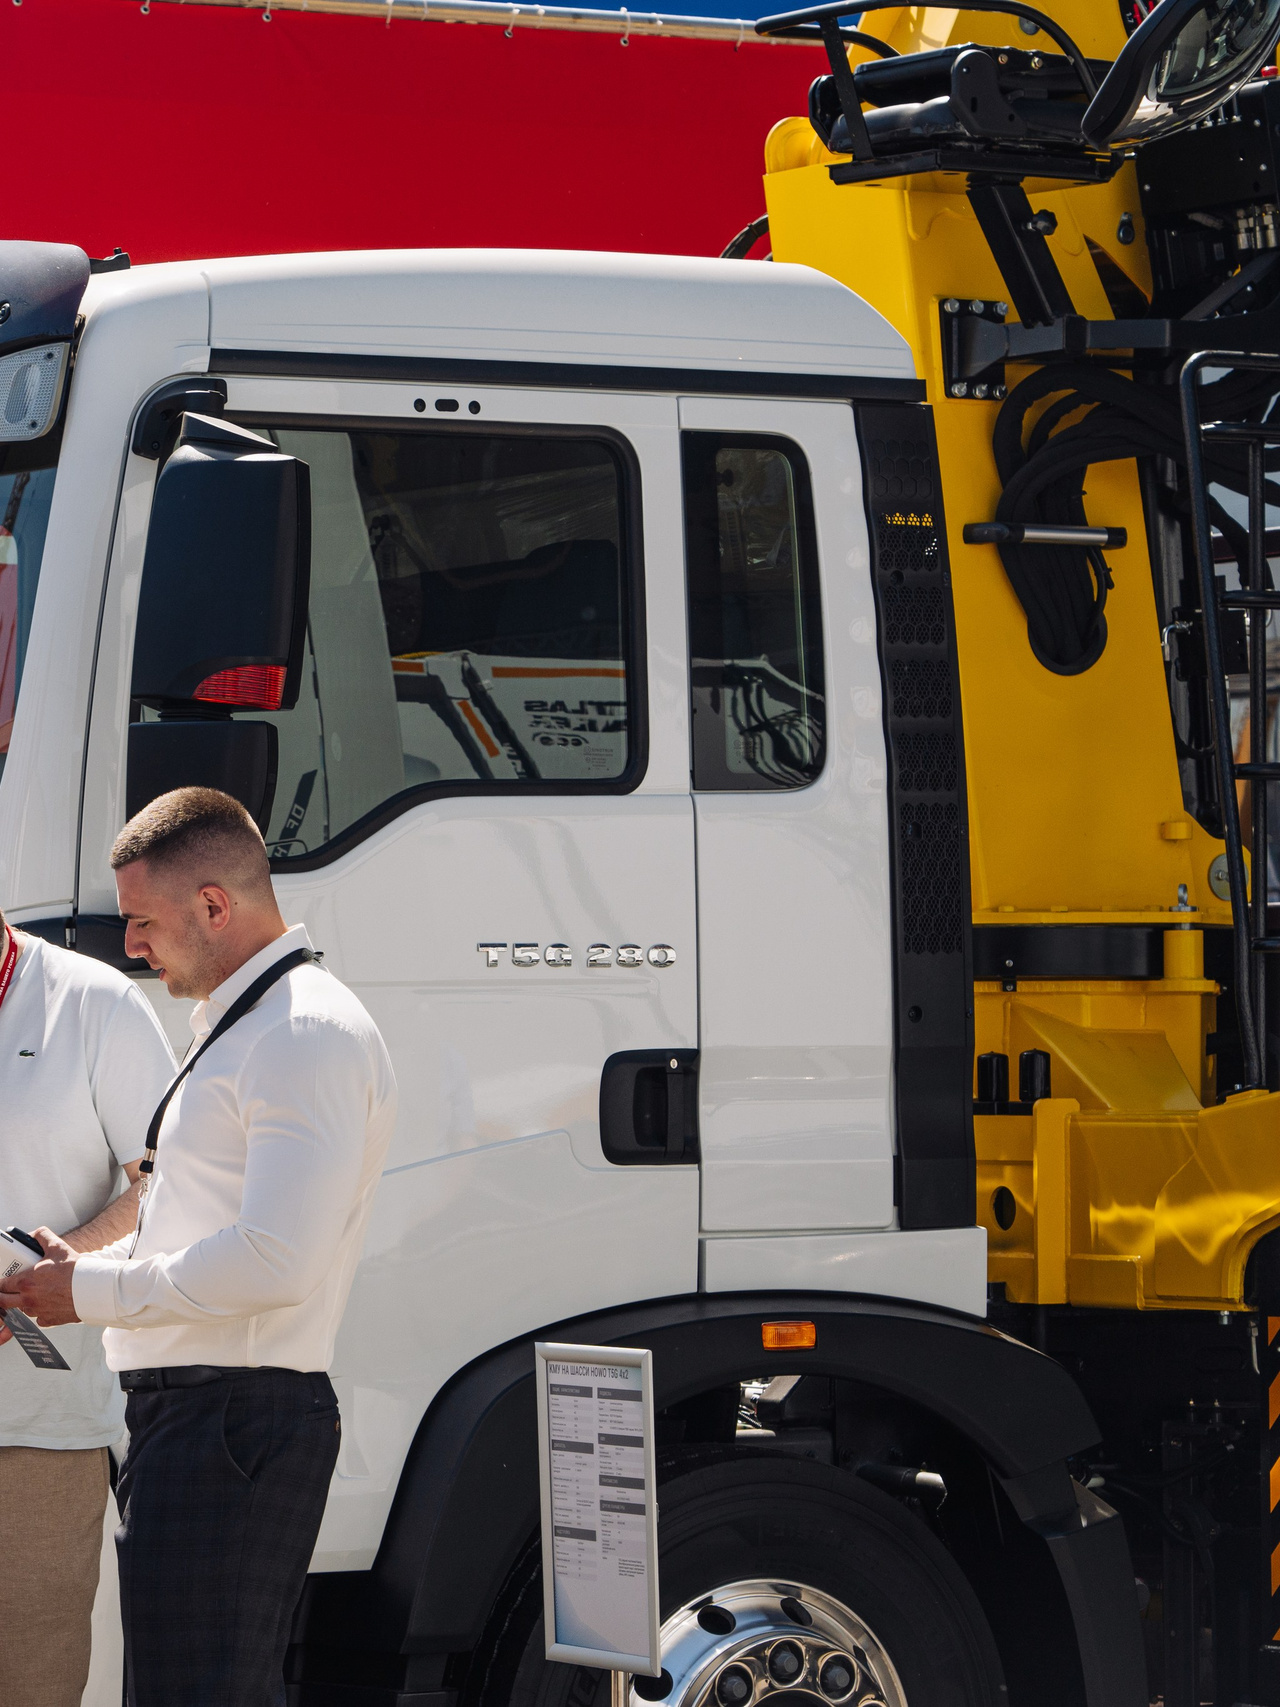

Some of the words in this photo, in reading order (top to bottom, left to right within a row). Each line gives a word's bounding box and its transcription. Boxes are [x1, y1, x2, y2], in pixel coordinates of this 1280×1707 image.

[477, 943, 572, 968] T5G
[587, 943, 677, 968] 280
[562, 1364, 570, 1375] НА
[590, 1367, 607, 1378] HOWO
